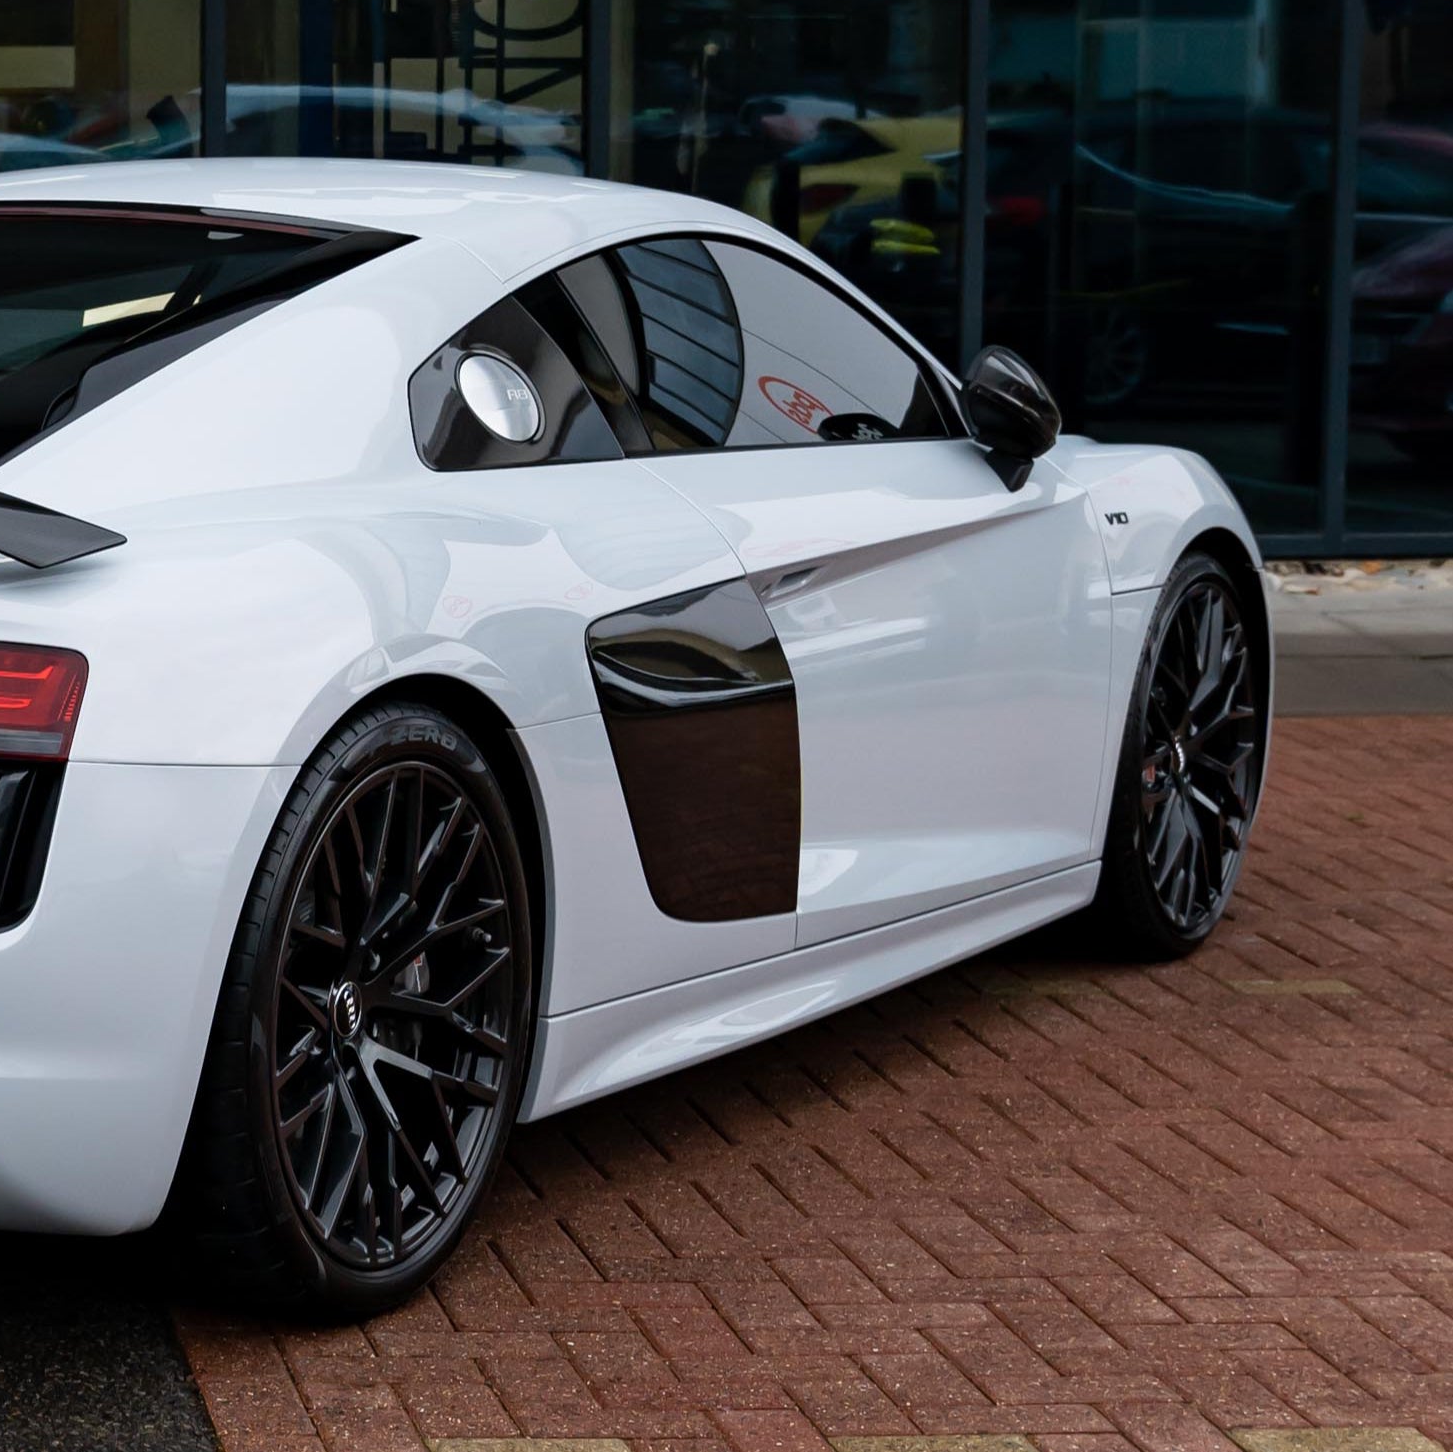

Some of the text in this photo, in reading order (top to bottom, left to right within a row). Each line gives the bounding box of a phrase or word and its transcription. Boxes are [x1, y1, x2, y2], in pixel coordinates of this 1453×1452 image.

[506, 388, 529, 401] R8
[1104, 512, 1129, 525] V10
[390, 724, 458, 751] ZERO
